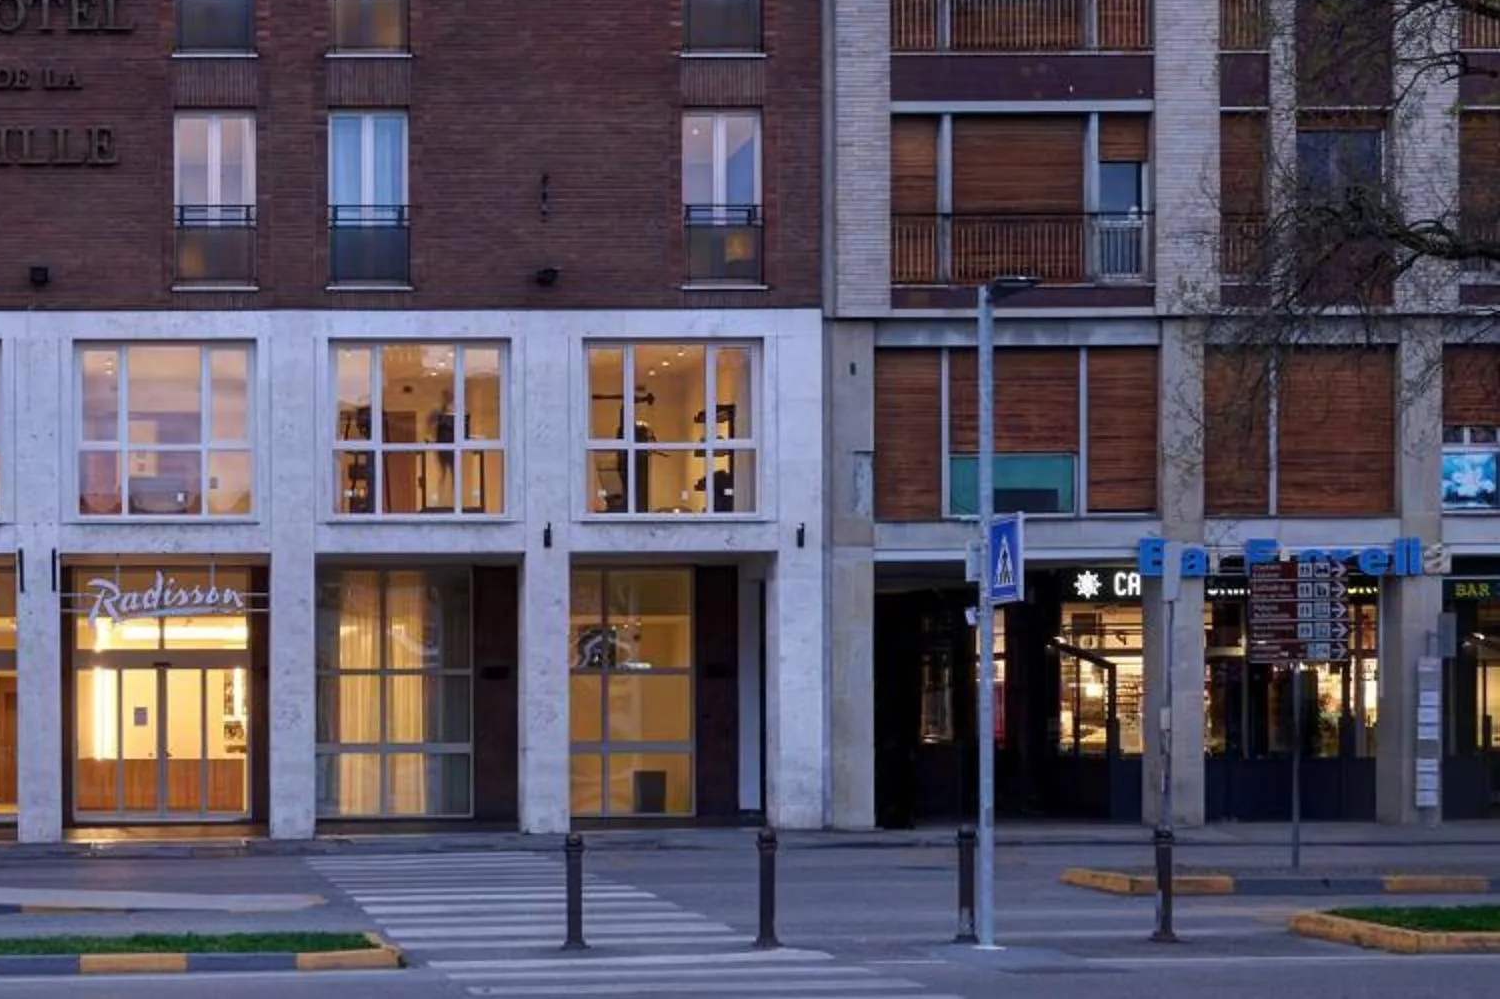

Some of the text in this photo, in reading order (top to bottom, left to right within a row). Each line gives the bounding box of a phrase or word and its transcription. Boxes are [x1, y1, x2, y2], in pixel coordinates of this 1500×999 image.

[42, 68, 82, 90] LA
[87, 569, 244, 626] Radisson
[1455, 583, 1491, 598] BAR
